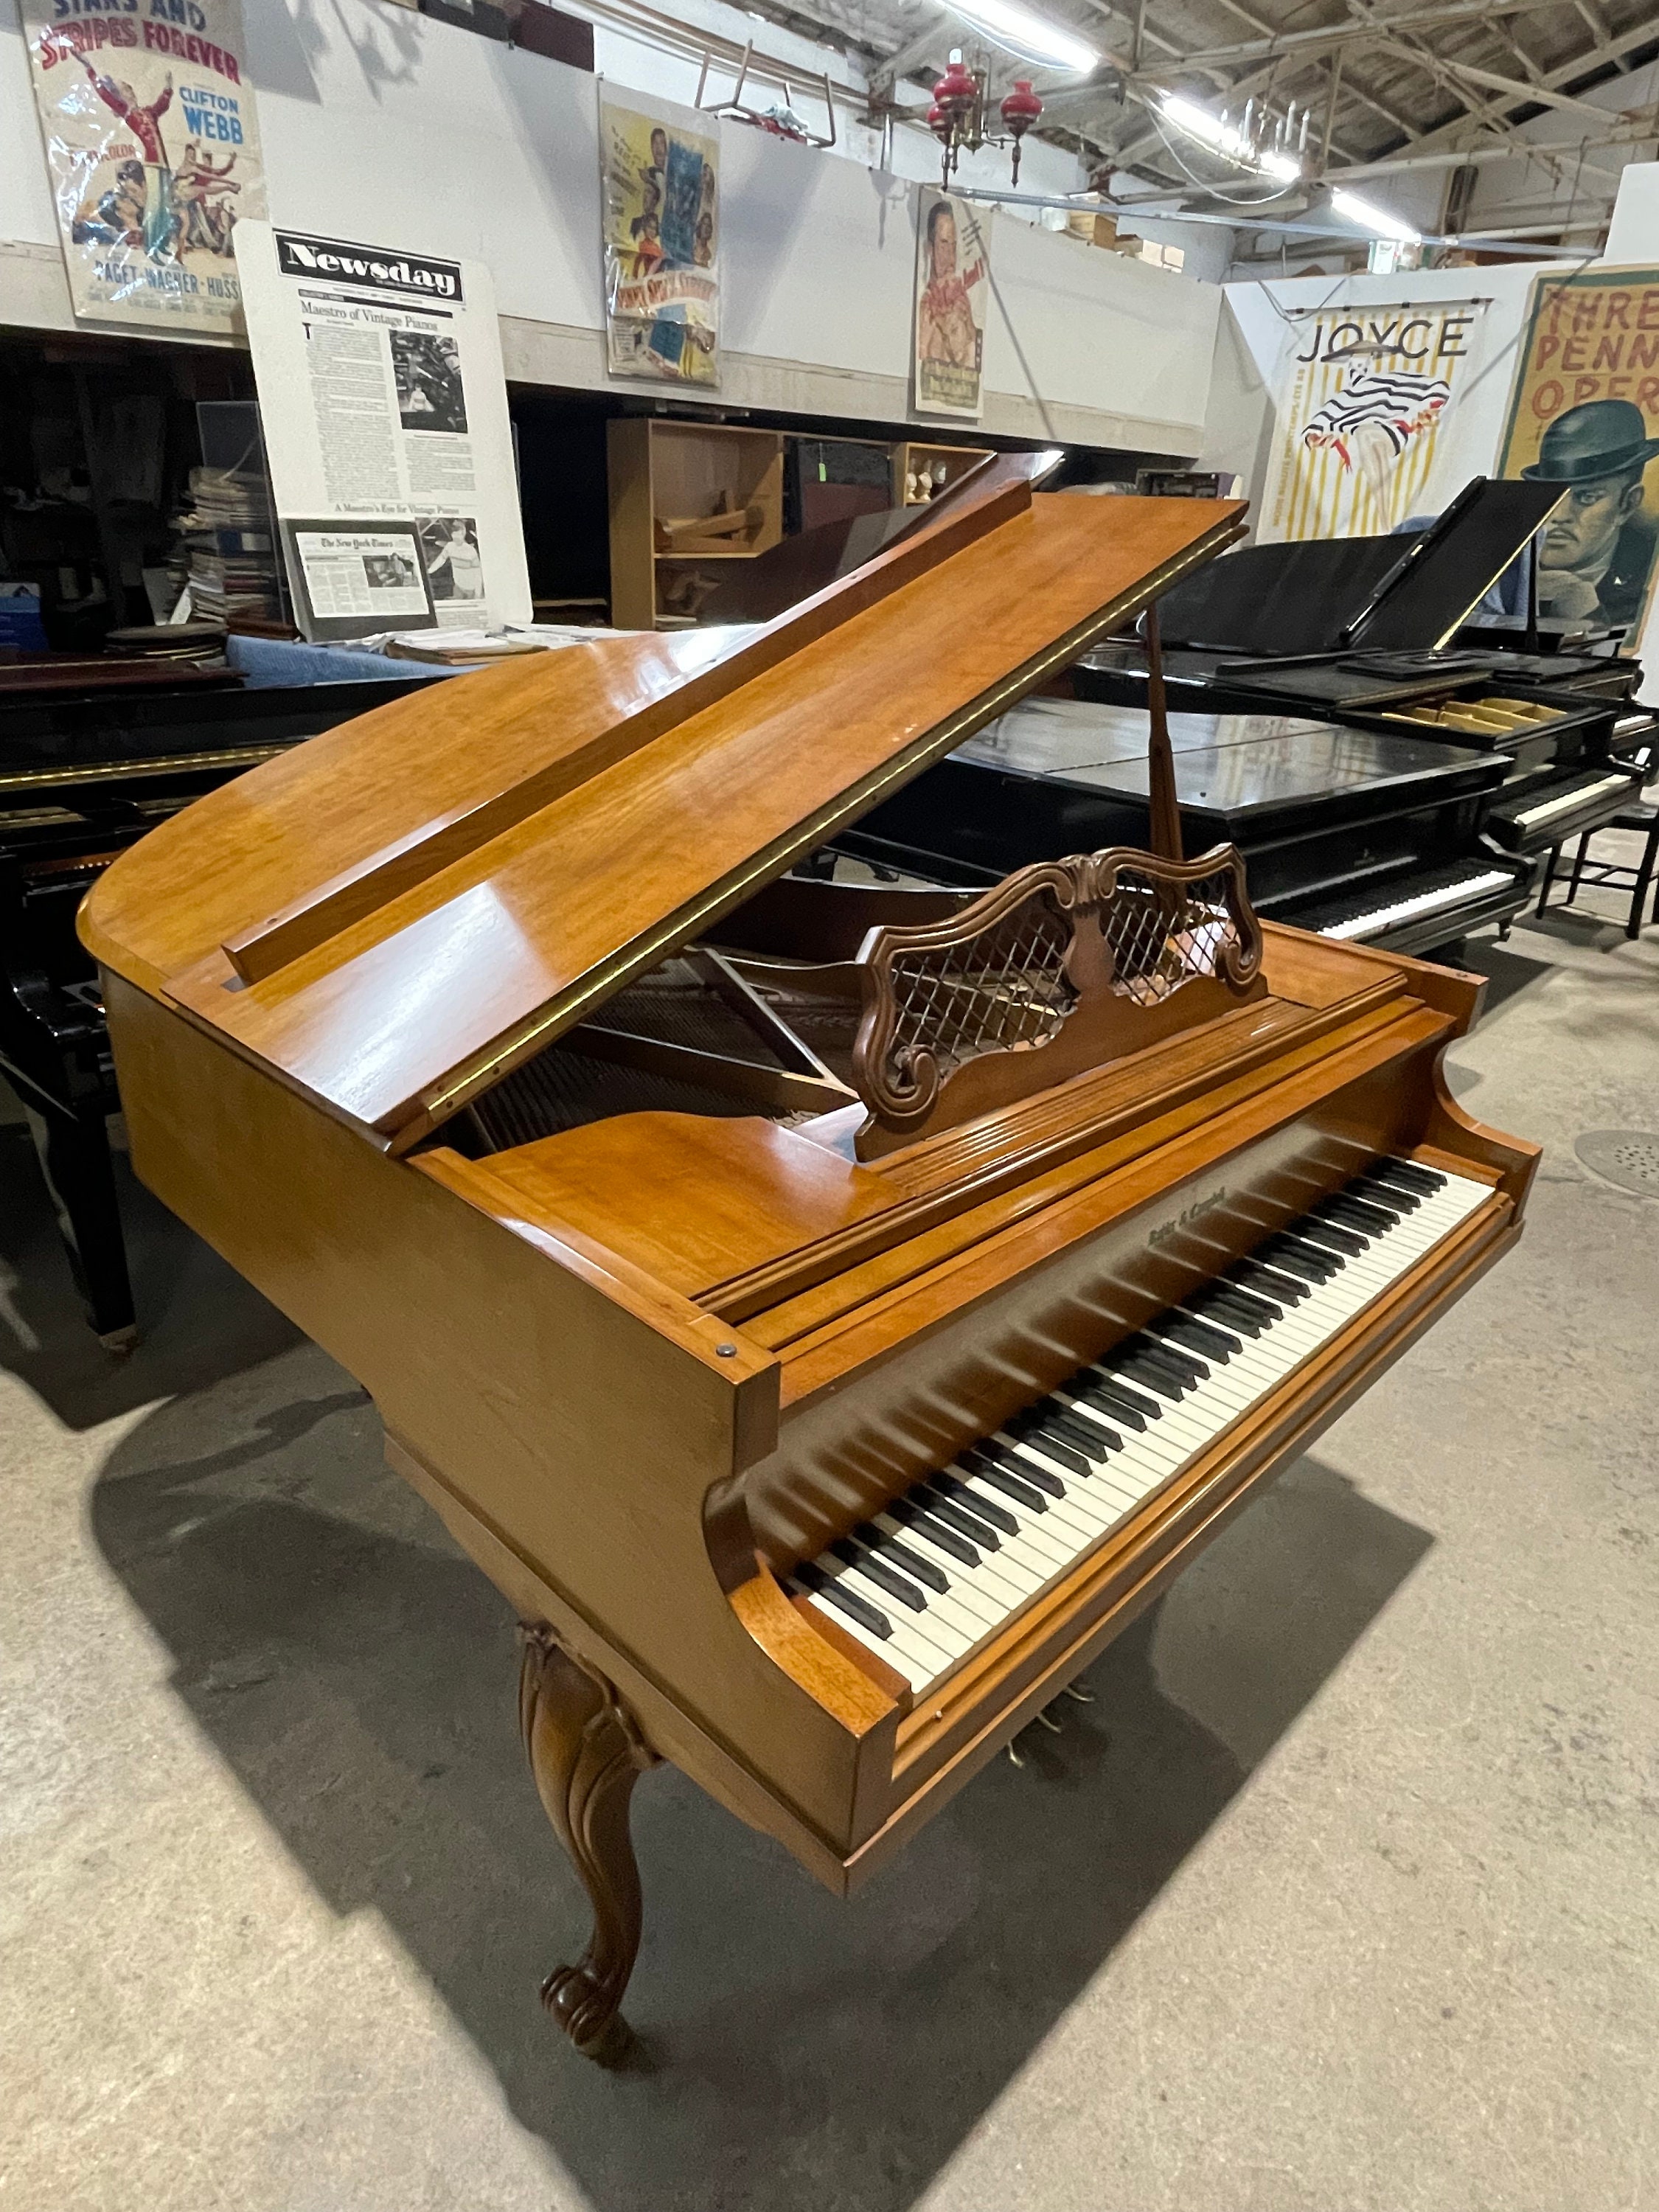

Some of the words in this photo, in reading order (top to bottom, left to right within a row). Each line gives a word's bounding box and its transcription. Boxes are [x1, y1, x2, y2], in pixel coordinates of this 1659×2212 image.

[150, 0, 207, 32] AND
[40, 17, 138, 71] STRIPES
[142, 20, 241, 86] FOREVER
[178, 86, 238, 114] CLIFTON
[182, 105, 243, 145] WEBB
[206, 276, 241, 300] HUSS
[284, 241, 455, 296] Newsday
[301, 300, 347, 319] Maestro
[349, 308, 360, 319] of
[363, 309, 403, 327] Vintage
[406, 315, 439, 331] Pianos
[1548, 291, 1659, 335] THRE
[1296, 317, 1474, 362] JOYCE
[1536, 334, 1659, 372] PENN
[1531, 376, 1659, 420] OPER
[321, 538, 334, 547] The
[336, 538, 352, 547] New
[353, 538, 371, 549] York
[372, 538, 393, 547] Times
